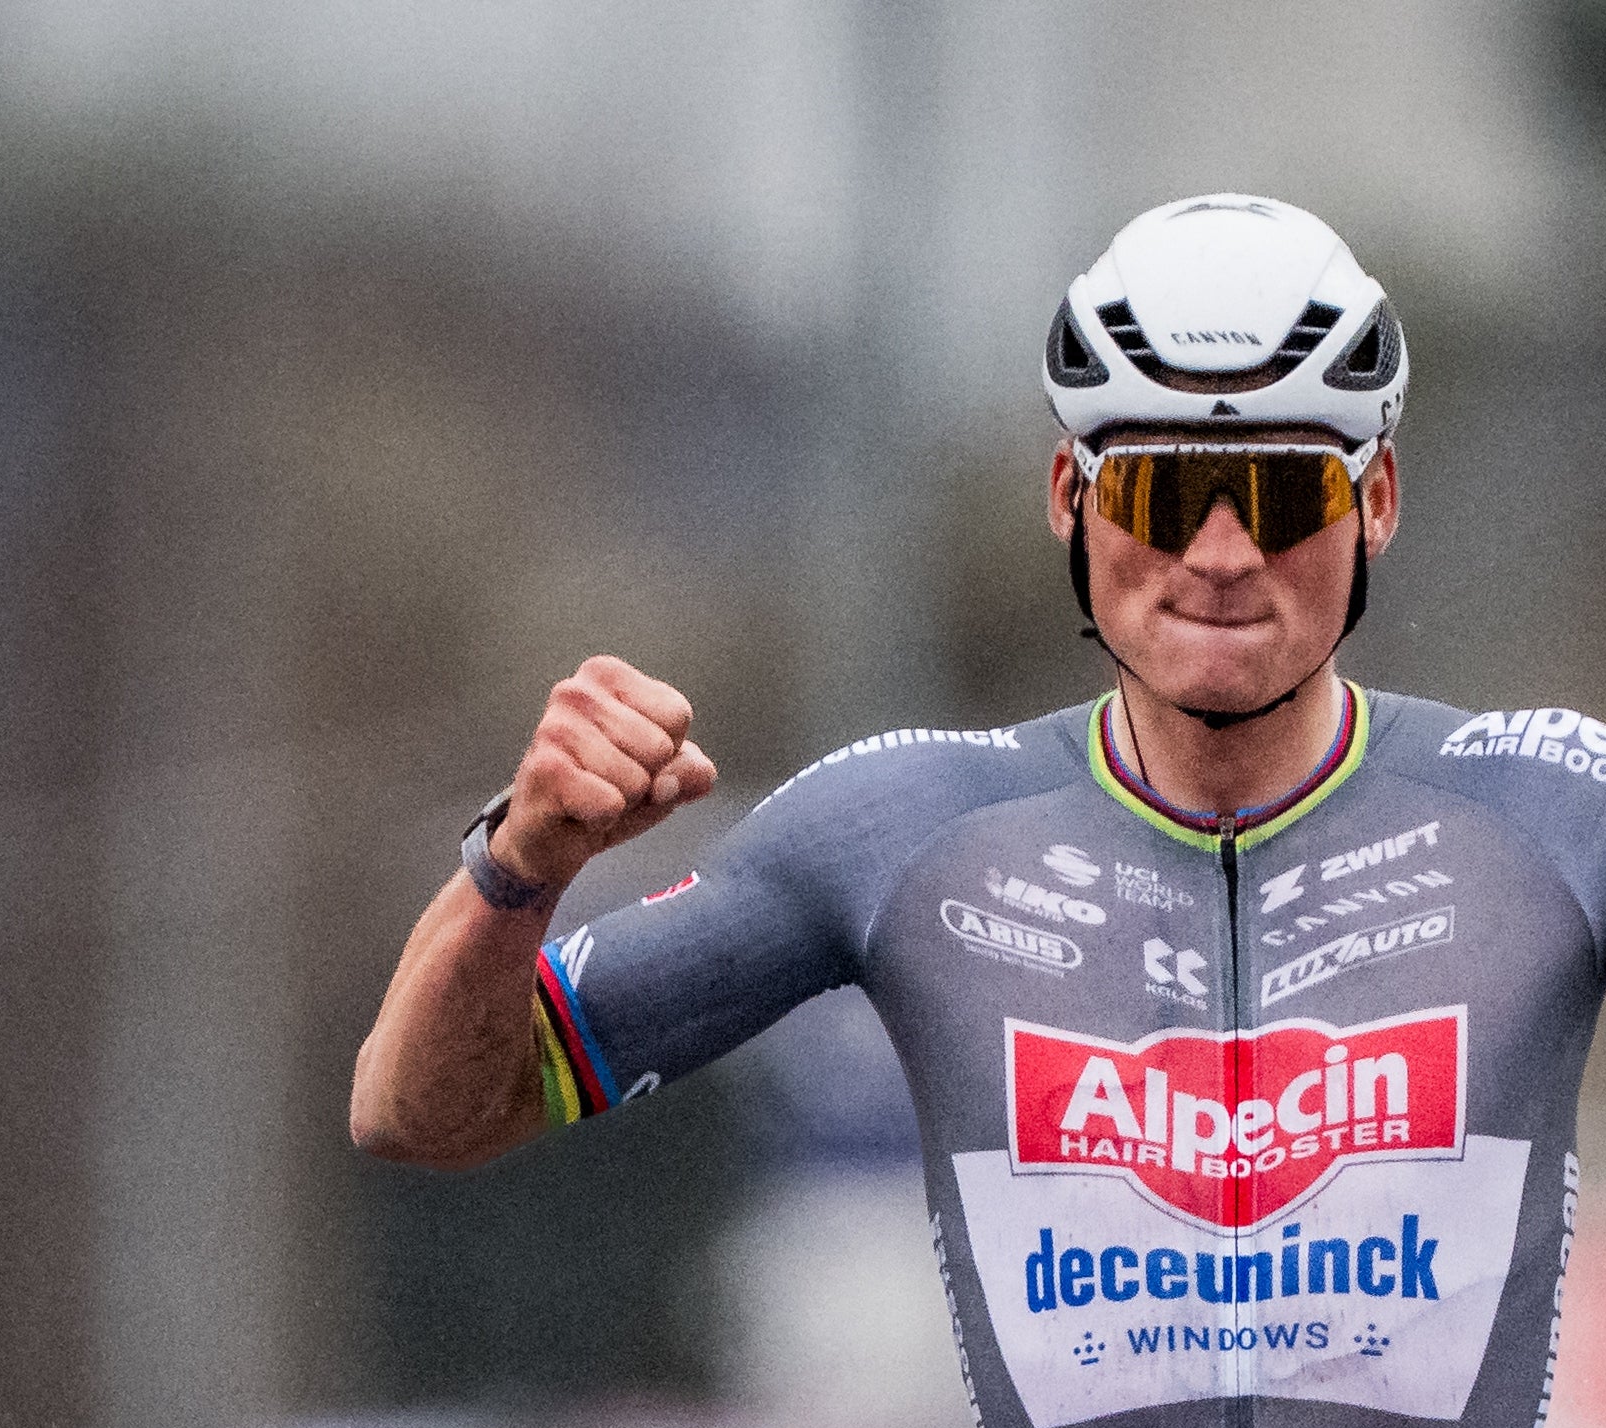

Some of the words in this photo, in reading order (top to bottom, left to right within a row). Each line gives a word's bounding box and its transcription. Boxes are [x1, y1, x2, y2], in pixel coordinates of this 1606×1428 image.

[1439, 736, 1521, 757] HAIR
[1115, 861, 1158, 883] UCI
[1320, 820, 1440, 881] ZWIFT
[960, 911, 1064, 961] ABUS
[1261, 870, 1455, 946] CANYON
[1060, 1044, 1408, 1174] Alpecin
[1060, 1134, 1167, 1168] HAIR
[1201, 1119, 1410, 1179] BOOSTER
[1026, 1214, 1441, 1313] deceuninck
[1128, 1322, 1330, 1354] WINDOWS
